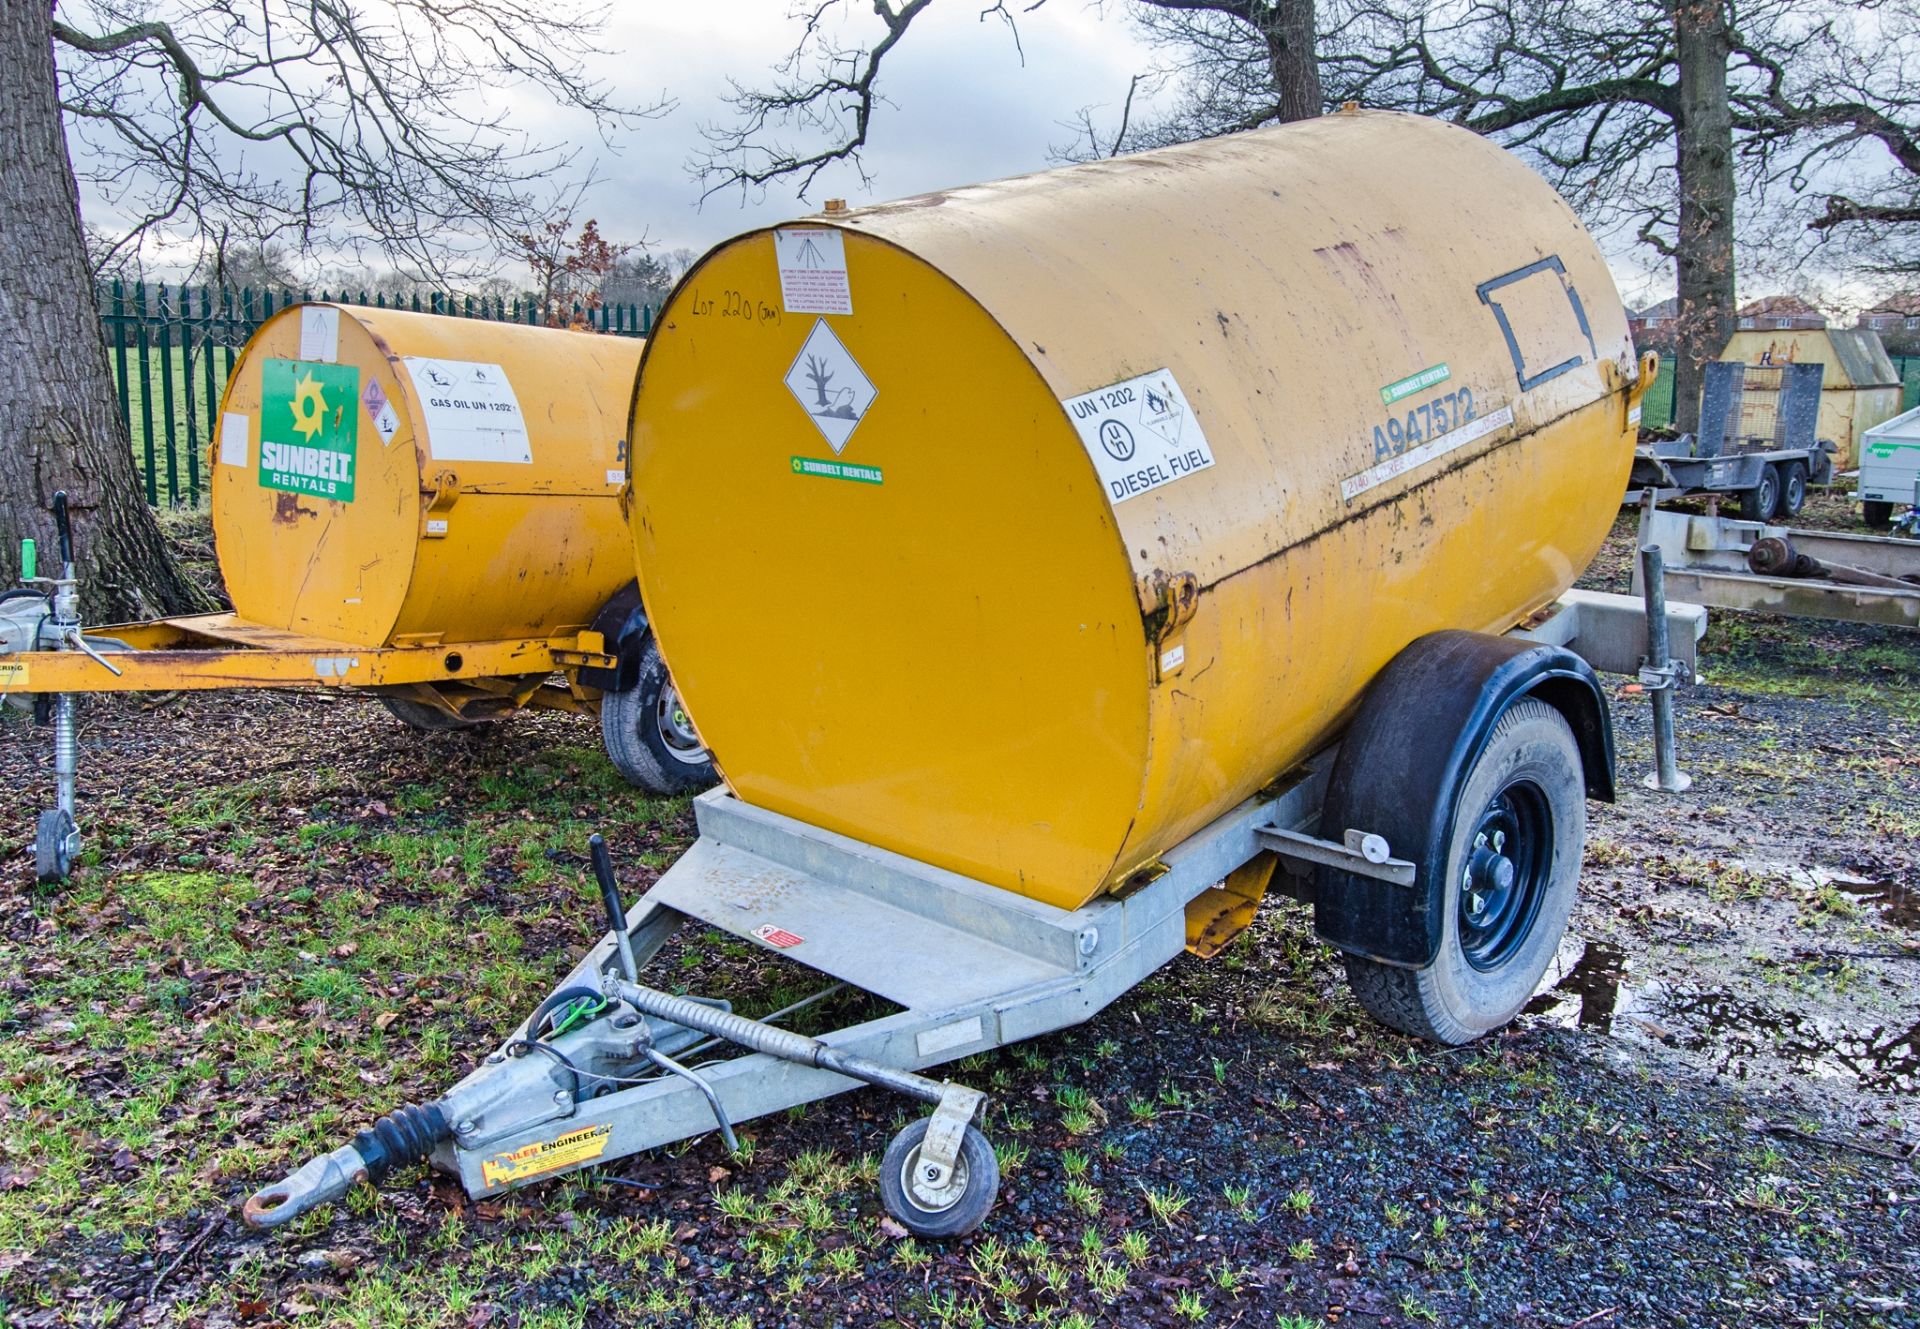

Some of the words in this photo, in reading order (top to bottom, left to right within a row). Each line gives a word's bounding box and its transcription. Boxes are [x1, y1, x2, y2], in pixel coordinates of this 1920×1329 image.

[722, 290, 752, 320] 220
[758, 301, 781, 327] (JAN)
[1391, 377, 1421, 397] SUNBELT
[1422, 366, 1450, 385] RENTALS
[431, 398, 451, 408] GAS
[454, 400, 470, 409] OIL
[473, 402, 487, 410] UN
[489, 403, 511, 412] 1202
[1072, 399, 1098, 419] UN
[1100, 387, 1136, 410] 1202
[1373, 386, 1477, 464] A947572
[262, 441, 352, 483] SUNBELT
[803, 461, 840, 475] SUNBELT
[842, 466, 882, 482] RENTALS
[1110, 464, 1169, 499] DIESEL
[1169, 449, 1210, 476] FUEL
[273, 472, 336, 494] RENTALS
[1346, 473, 1369, 494] 2140
